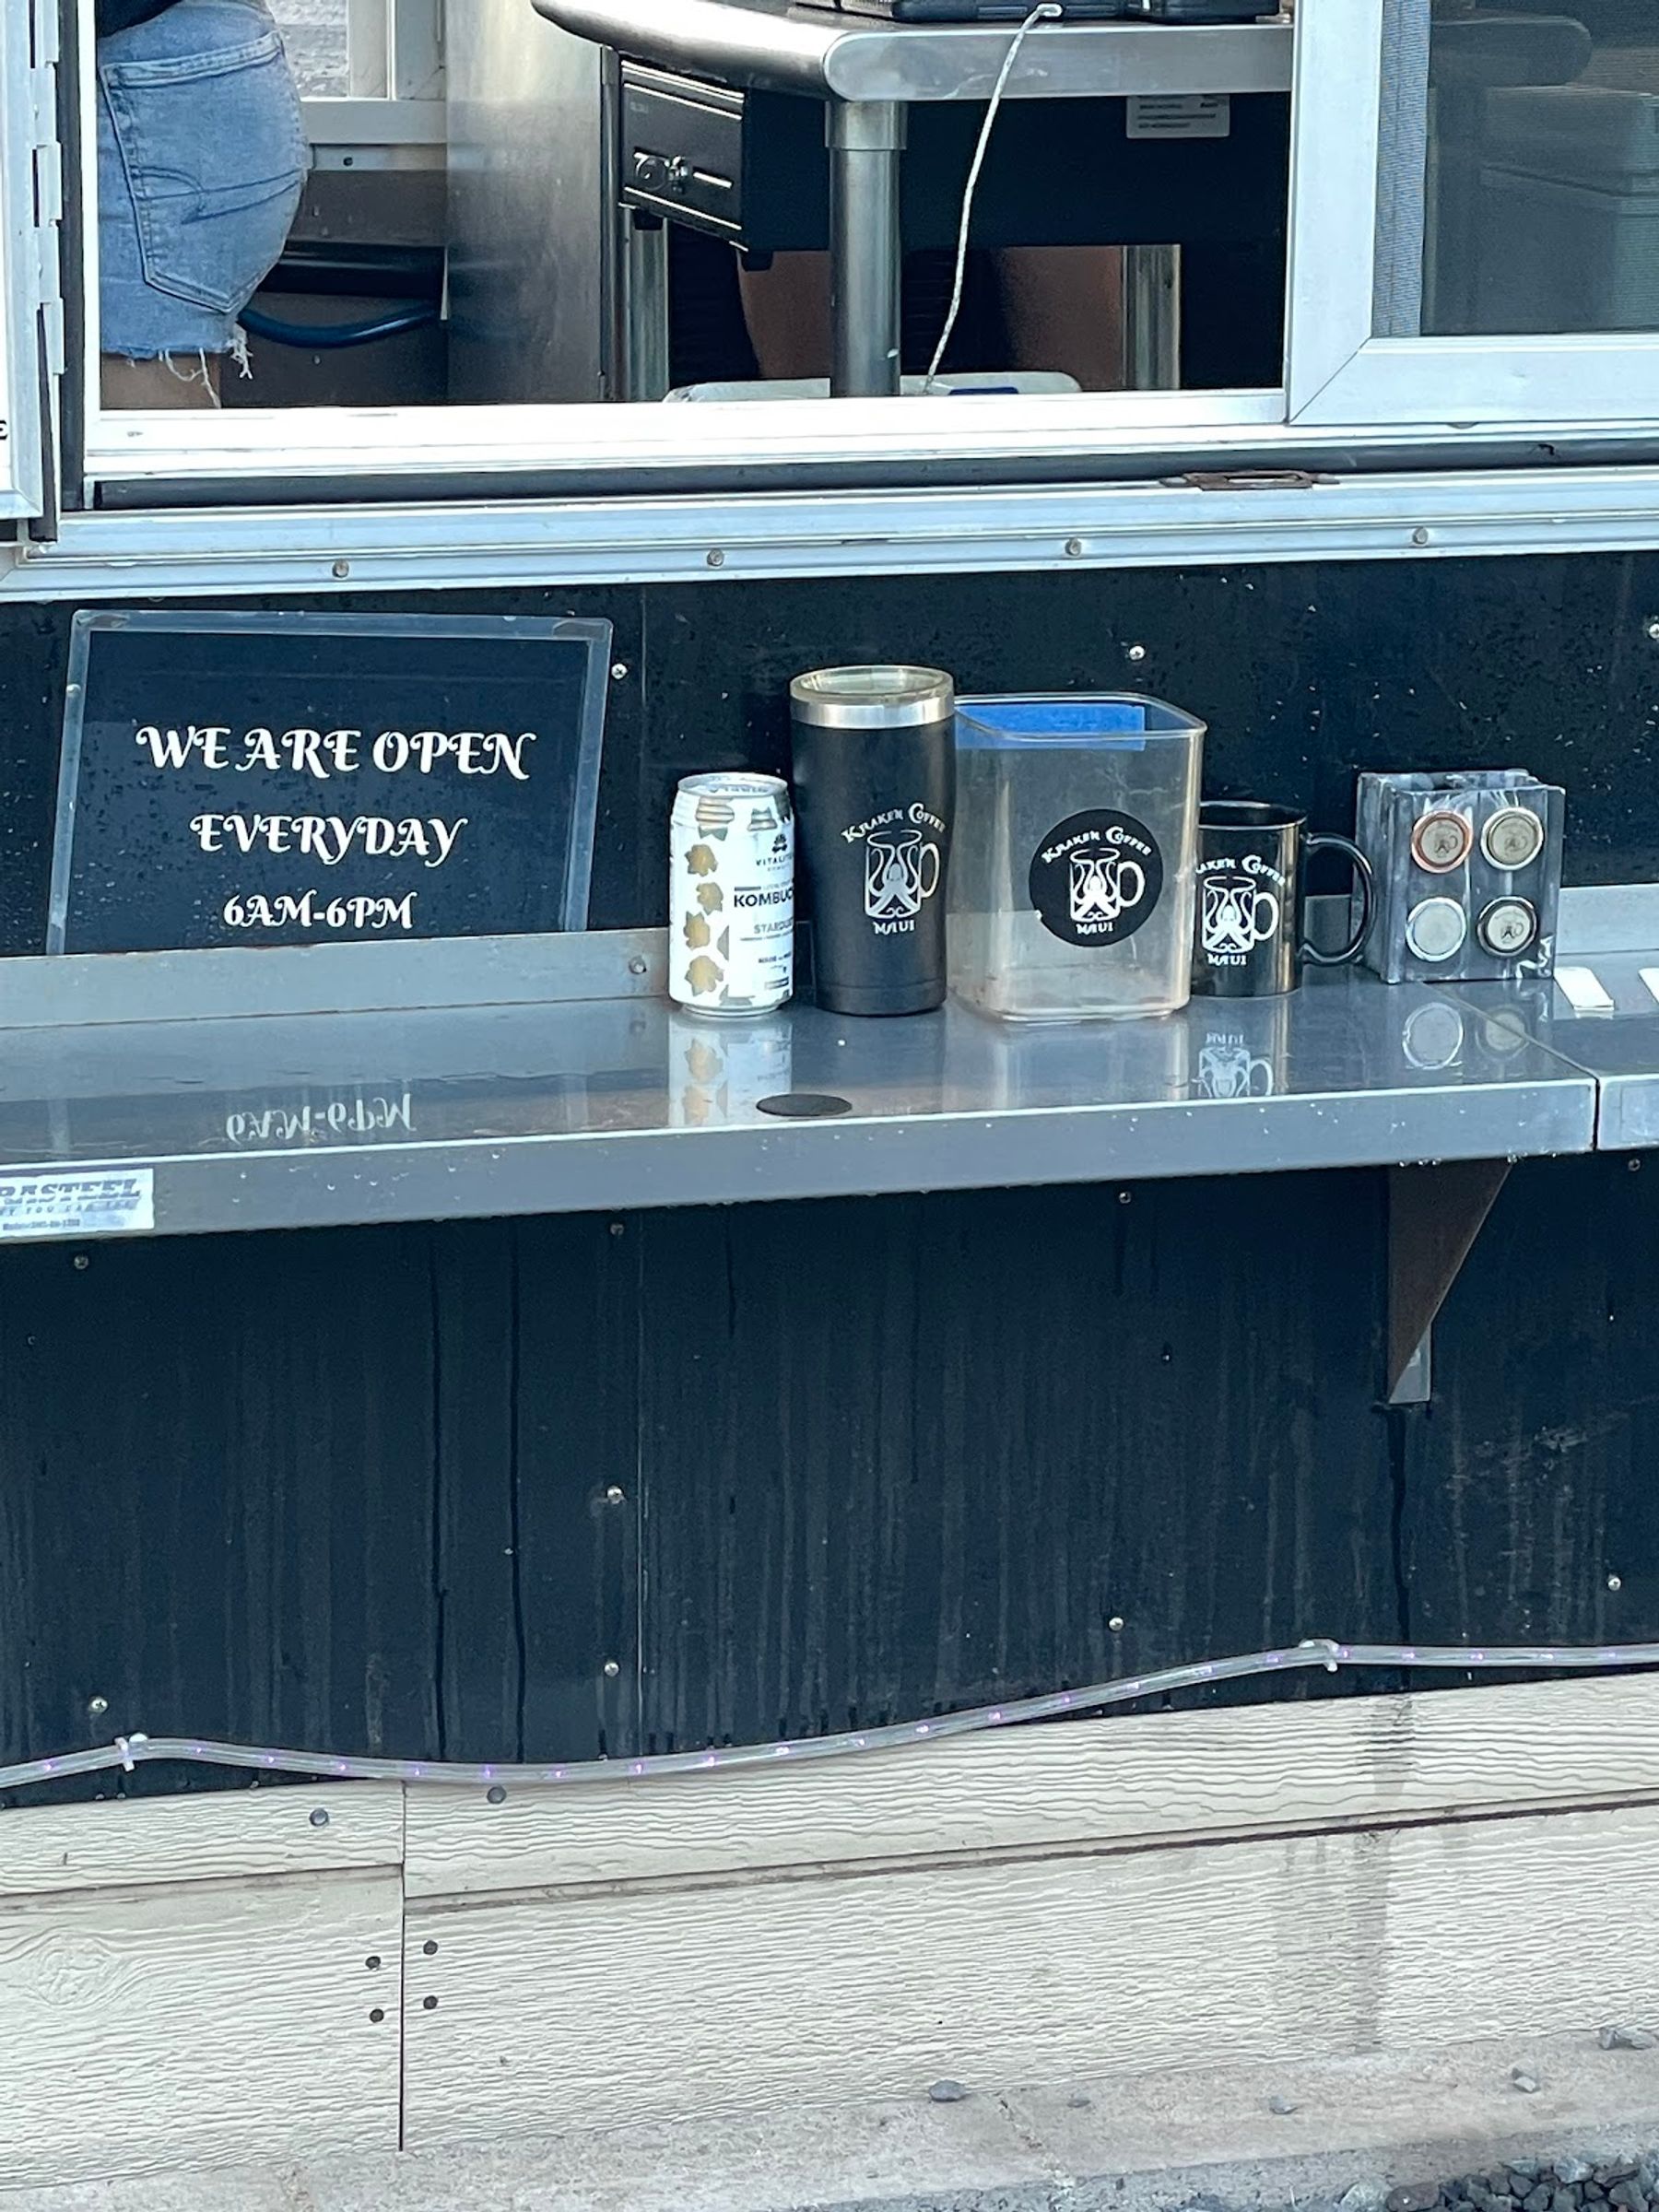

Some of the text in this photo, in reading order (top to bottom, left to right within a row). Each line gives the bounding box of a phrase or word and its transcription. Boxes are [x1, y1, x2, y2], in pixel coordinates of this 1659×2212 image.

[135, 725, 536, 780] WE ARE OPEN
[189, 814, 468, 867] EVERYDAY
[223, 888, 418, 929] 6AM-6PM
[872, 919, 915, 935] MAUI
[1076, 922, 1113, 935] MAUI
[1207, 953, 1247, 966] MAUI
